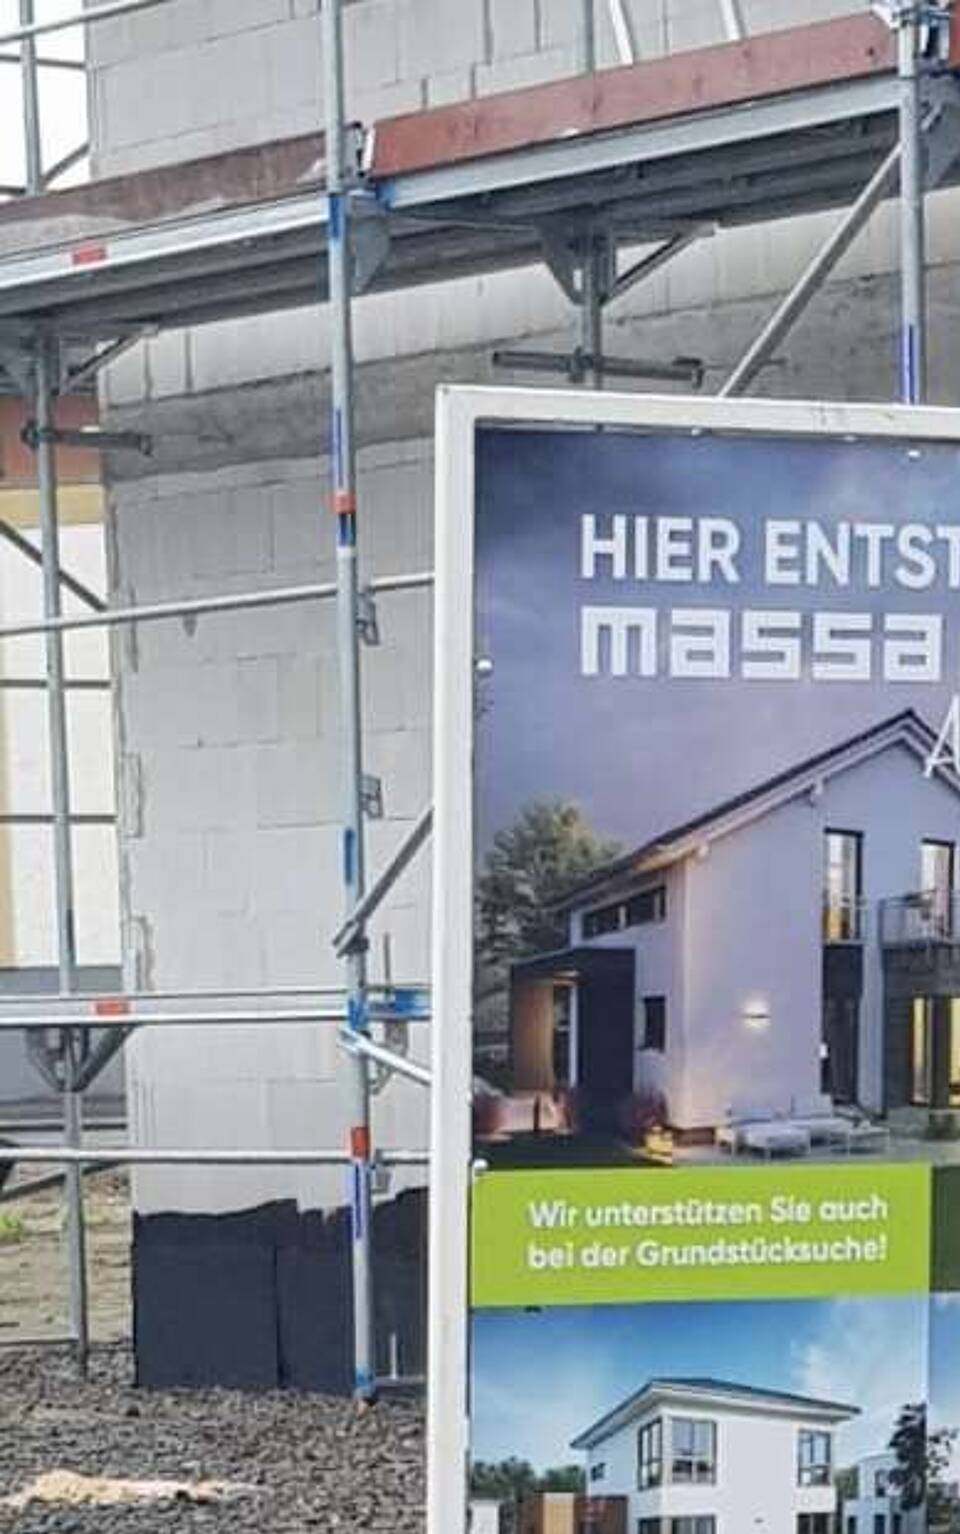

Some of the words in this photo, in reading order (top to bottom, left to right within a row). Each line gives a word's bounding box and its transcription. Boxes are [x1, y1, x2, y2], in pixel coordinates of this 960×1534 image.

[581, 513, 740, 583] HIER
[529, 1201, 578, 1227] Wir
[586, 1197, 763, 1226] unterstützen
[769, 1196, 809, 1223] Sie
[818, 1195, 888, 1222] auch
[528, 1242, 574, 1269] bei
[580, 1242, 630, 1267] der
[636, 1234, 887, 1267] Grundstücksuche!
